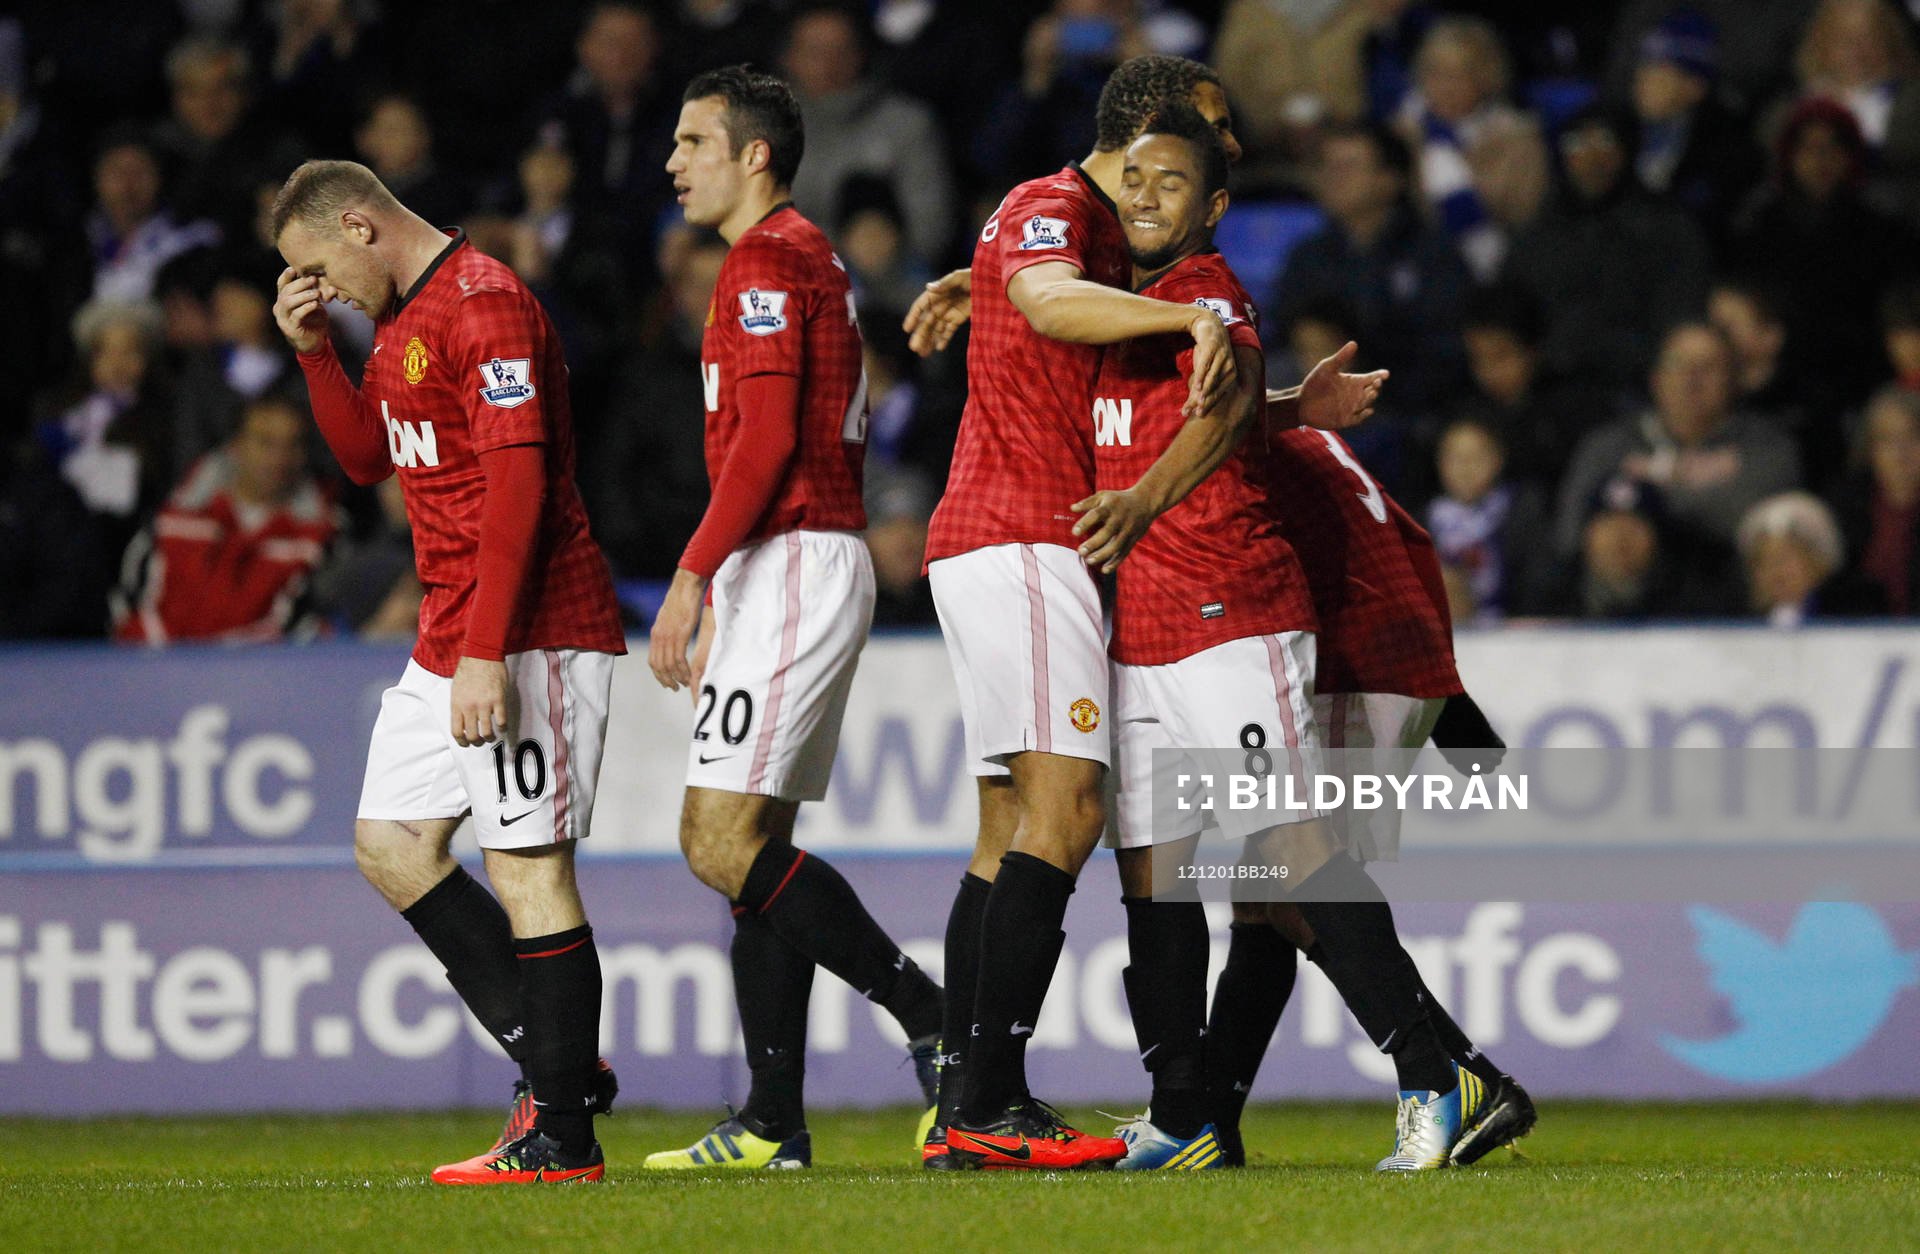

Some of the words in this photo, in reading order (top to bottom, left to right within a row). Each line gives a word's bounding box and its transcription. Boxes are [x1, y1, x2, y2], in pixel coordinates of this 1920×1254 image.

[490, 386, 521, 397] BARCLAYS
[694, 683, 753, 746] 20
[491, 738, 547, 805] 10
[1239, 722, 1273, 782] 8
